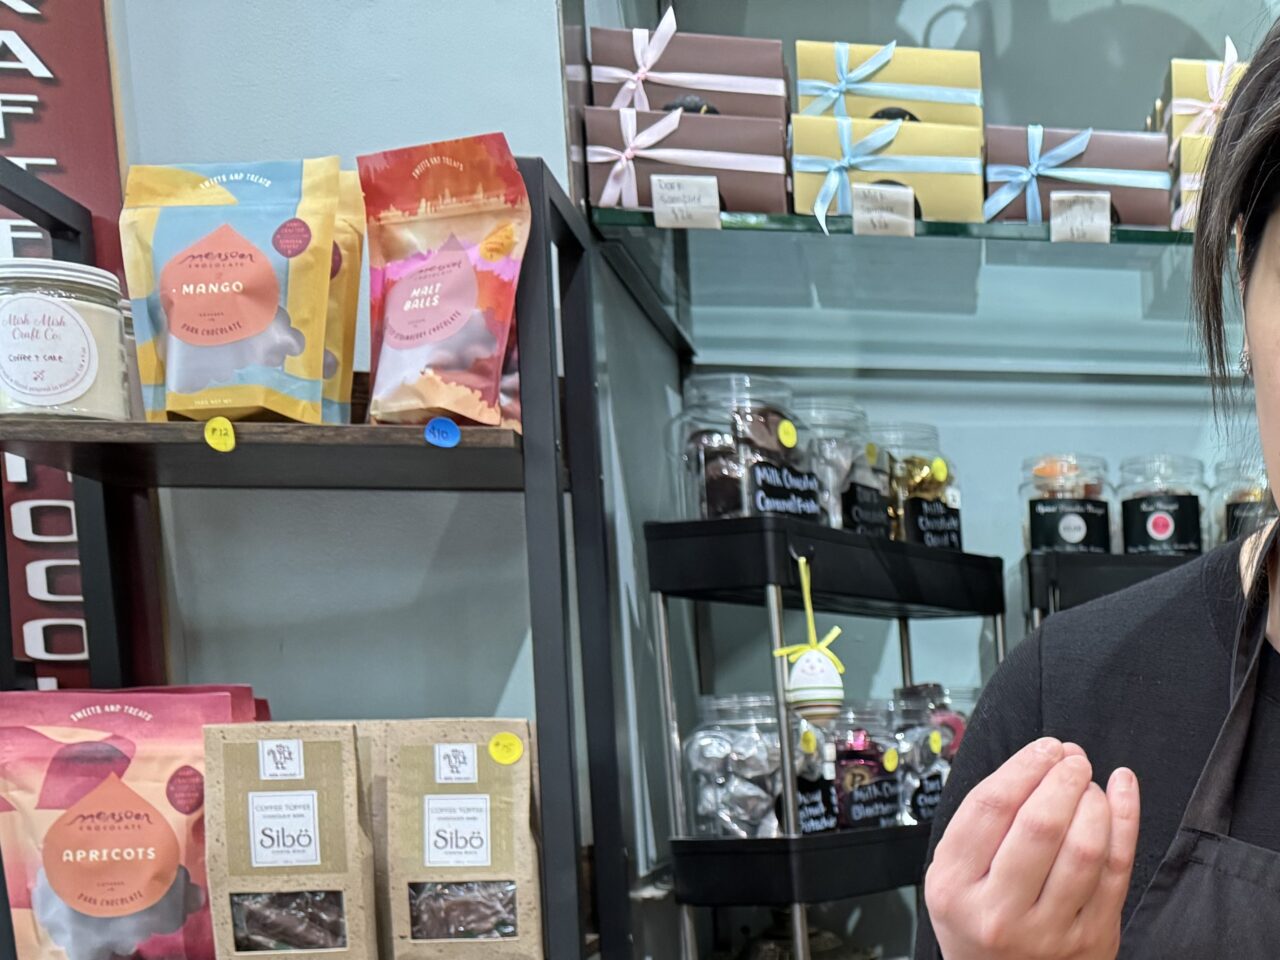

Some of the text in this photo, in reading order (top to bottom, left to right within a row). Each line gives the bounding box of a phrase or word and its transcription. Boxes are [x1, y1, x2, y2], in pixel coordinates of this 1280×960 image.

[182, 281, 244, 296] MANGO
[411, 283, 442, 297] MALT
[403, 295, 440, 311] BALLS
[181, 321, 243, 337] DARK CHOCOLATE
[104, 704, 121, 712] AND
[260, 826, 313, 850] Sibö
[433, 828, 484, 850] Sibö
[62, 847, 157, 862] APRICOTS
[99, 890, 144, 907] CHOCOLATE
